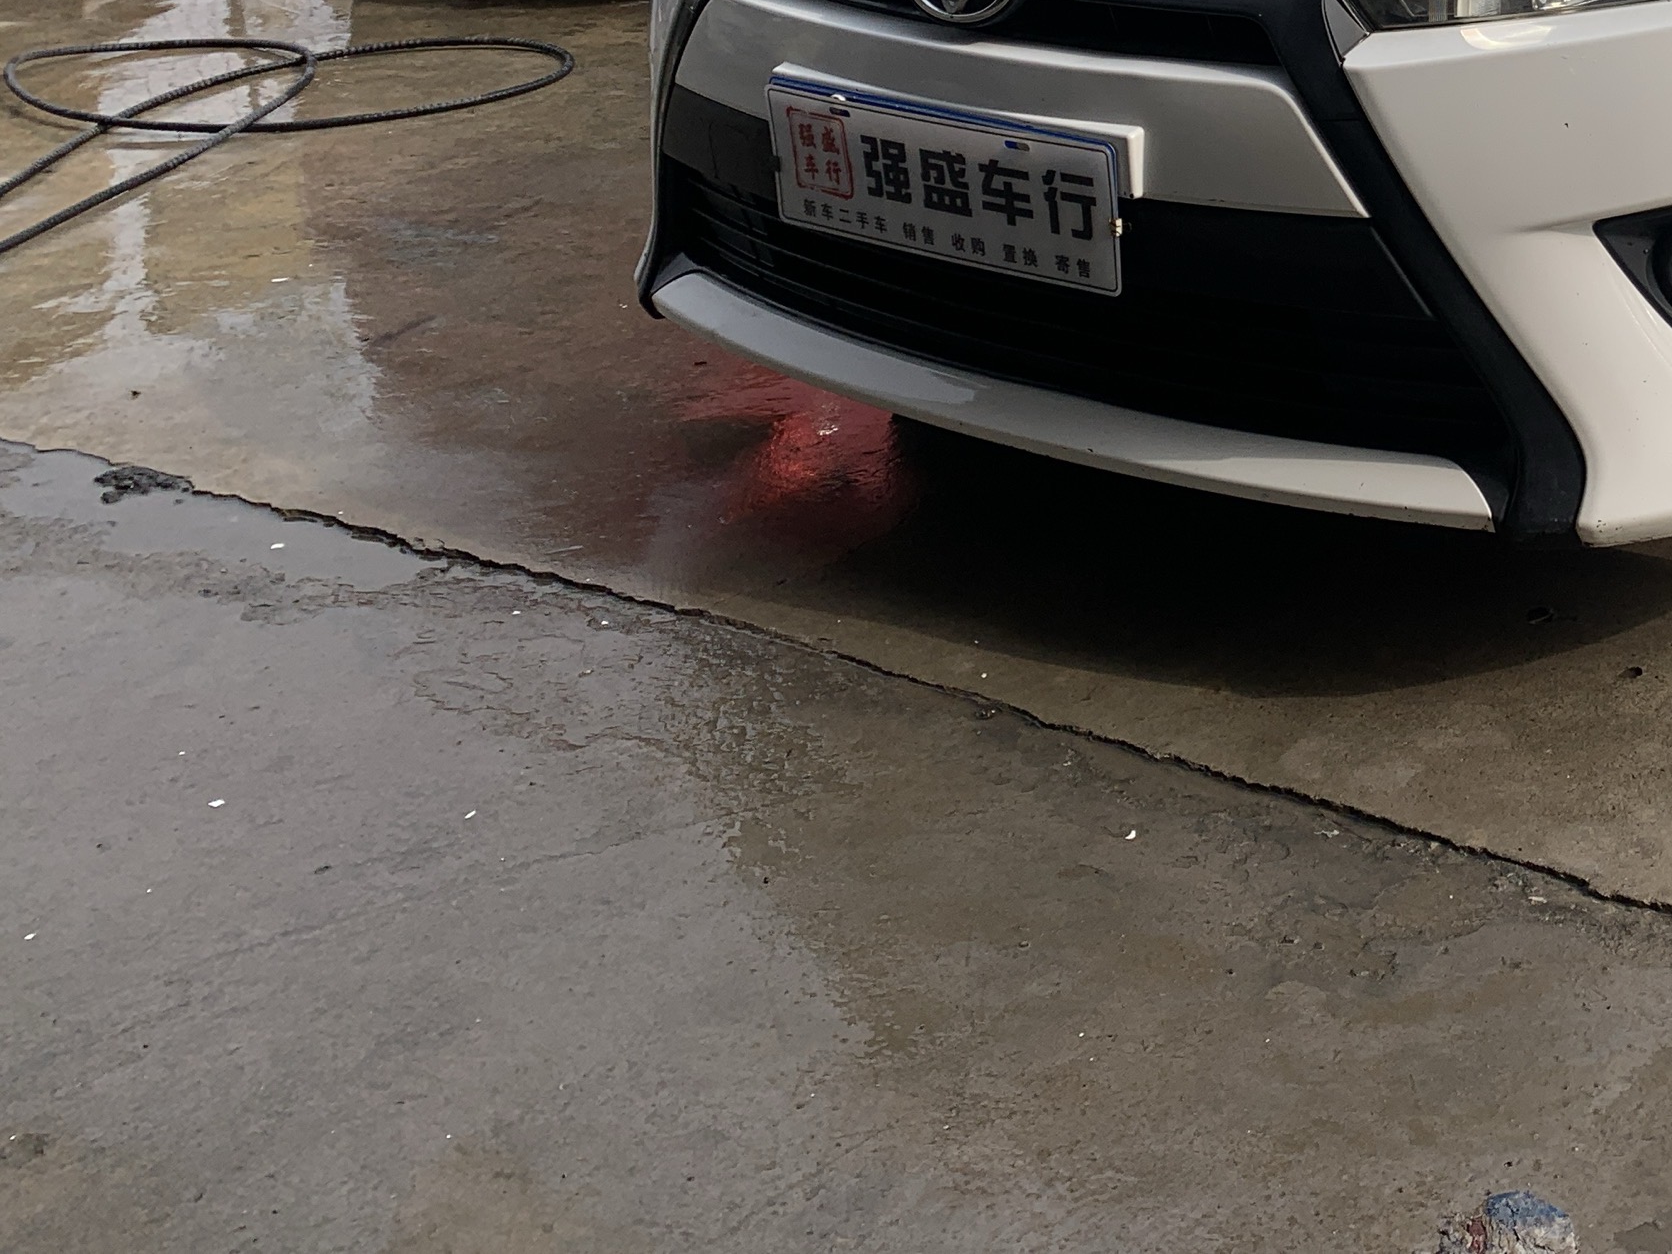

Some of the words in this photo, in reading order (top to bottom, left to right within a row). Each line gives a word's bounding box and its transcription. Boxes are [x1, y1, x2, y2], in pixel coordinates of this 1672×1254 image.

[860, 134, 1097, 241] 强盛车行
[803, 199, 888, 234] 新车二手车
[902, 222, 935, 246] 销售
[951, 233, 986, 257] 收购
[1003, 244, 1039, 268] 置换
[1055, 254, 1091, 279] 寄售
